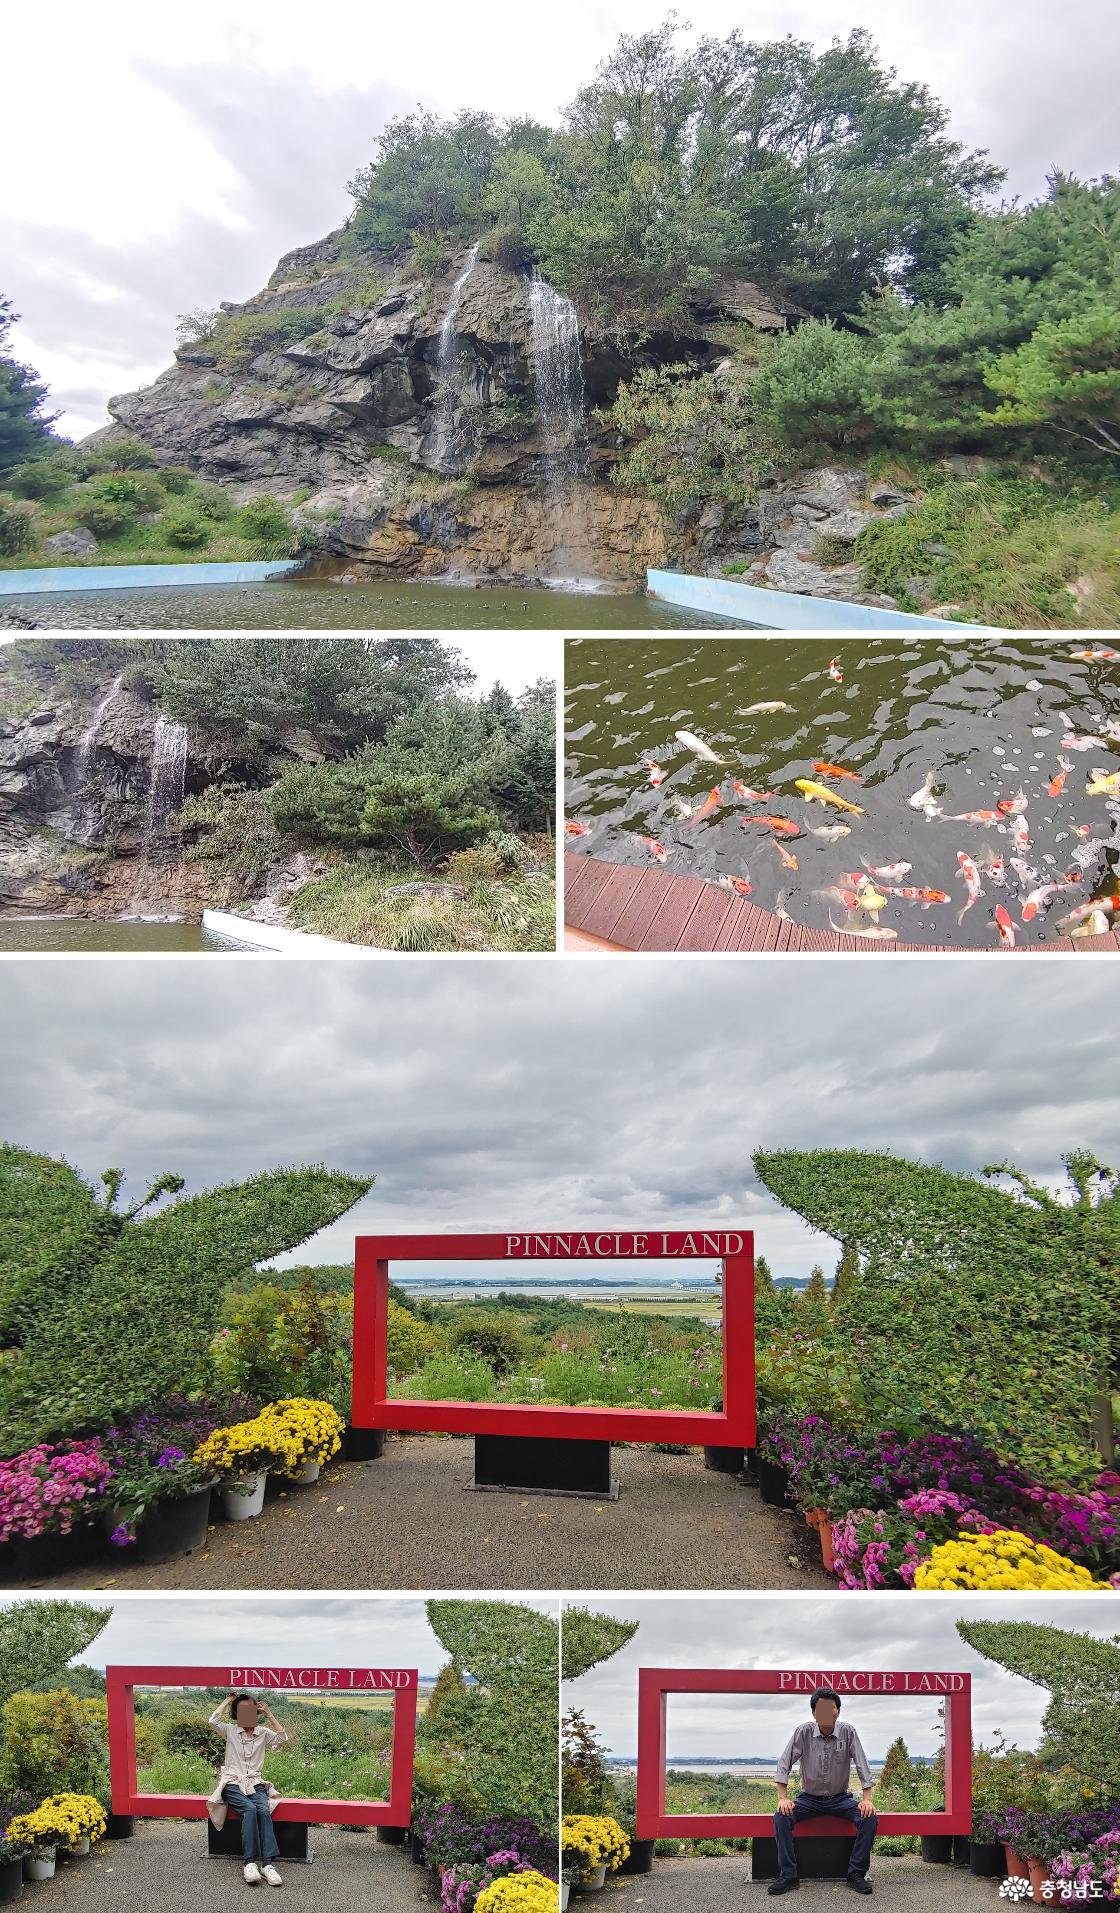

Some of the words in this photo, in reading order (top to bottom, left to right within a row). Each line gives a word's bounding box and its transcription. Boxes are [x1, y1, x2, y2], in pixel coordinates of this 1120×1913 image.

[504, 1233, 649, 1256] PINNACLE
[660, 1232, 744, 1255] LAND
[229, 1669, 340, 1687] PINNACLE
[348, 1670, 410, 1688] LAND
[778, 1672, 895, 1691] PINNACLE
[904, 1673, 964, 1691] LAND
